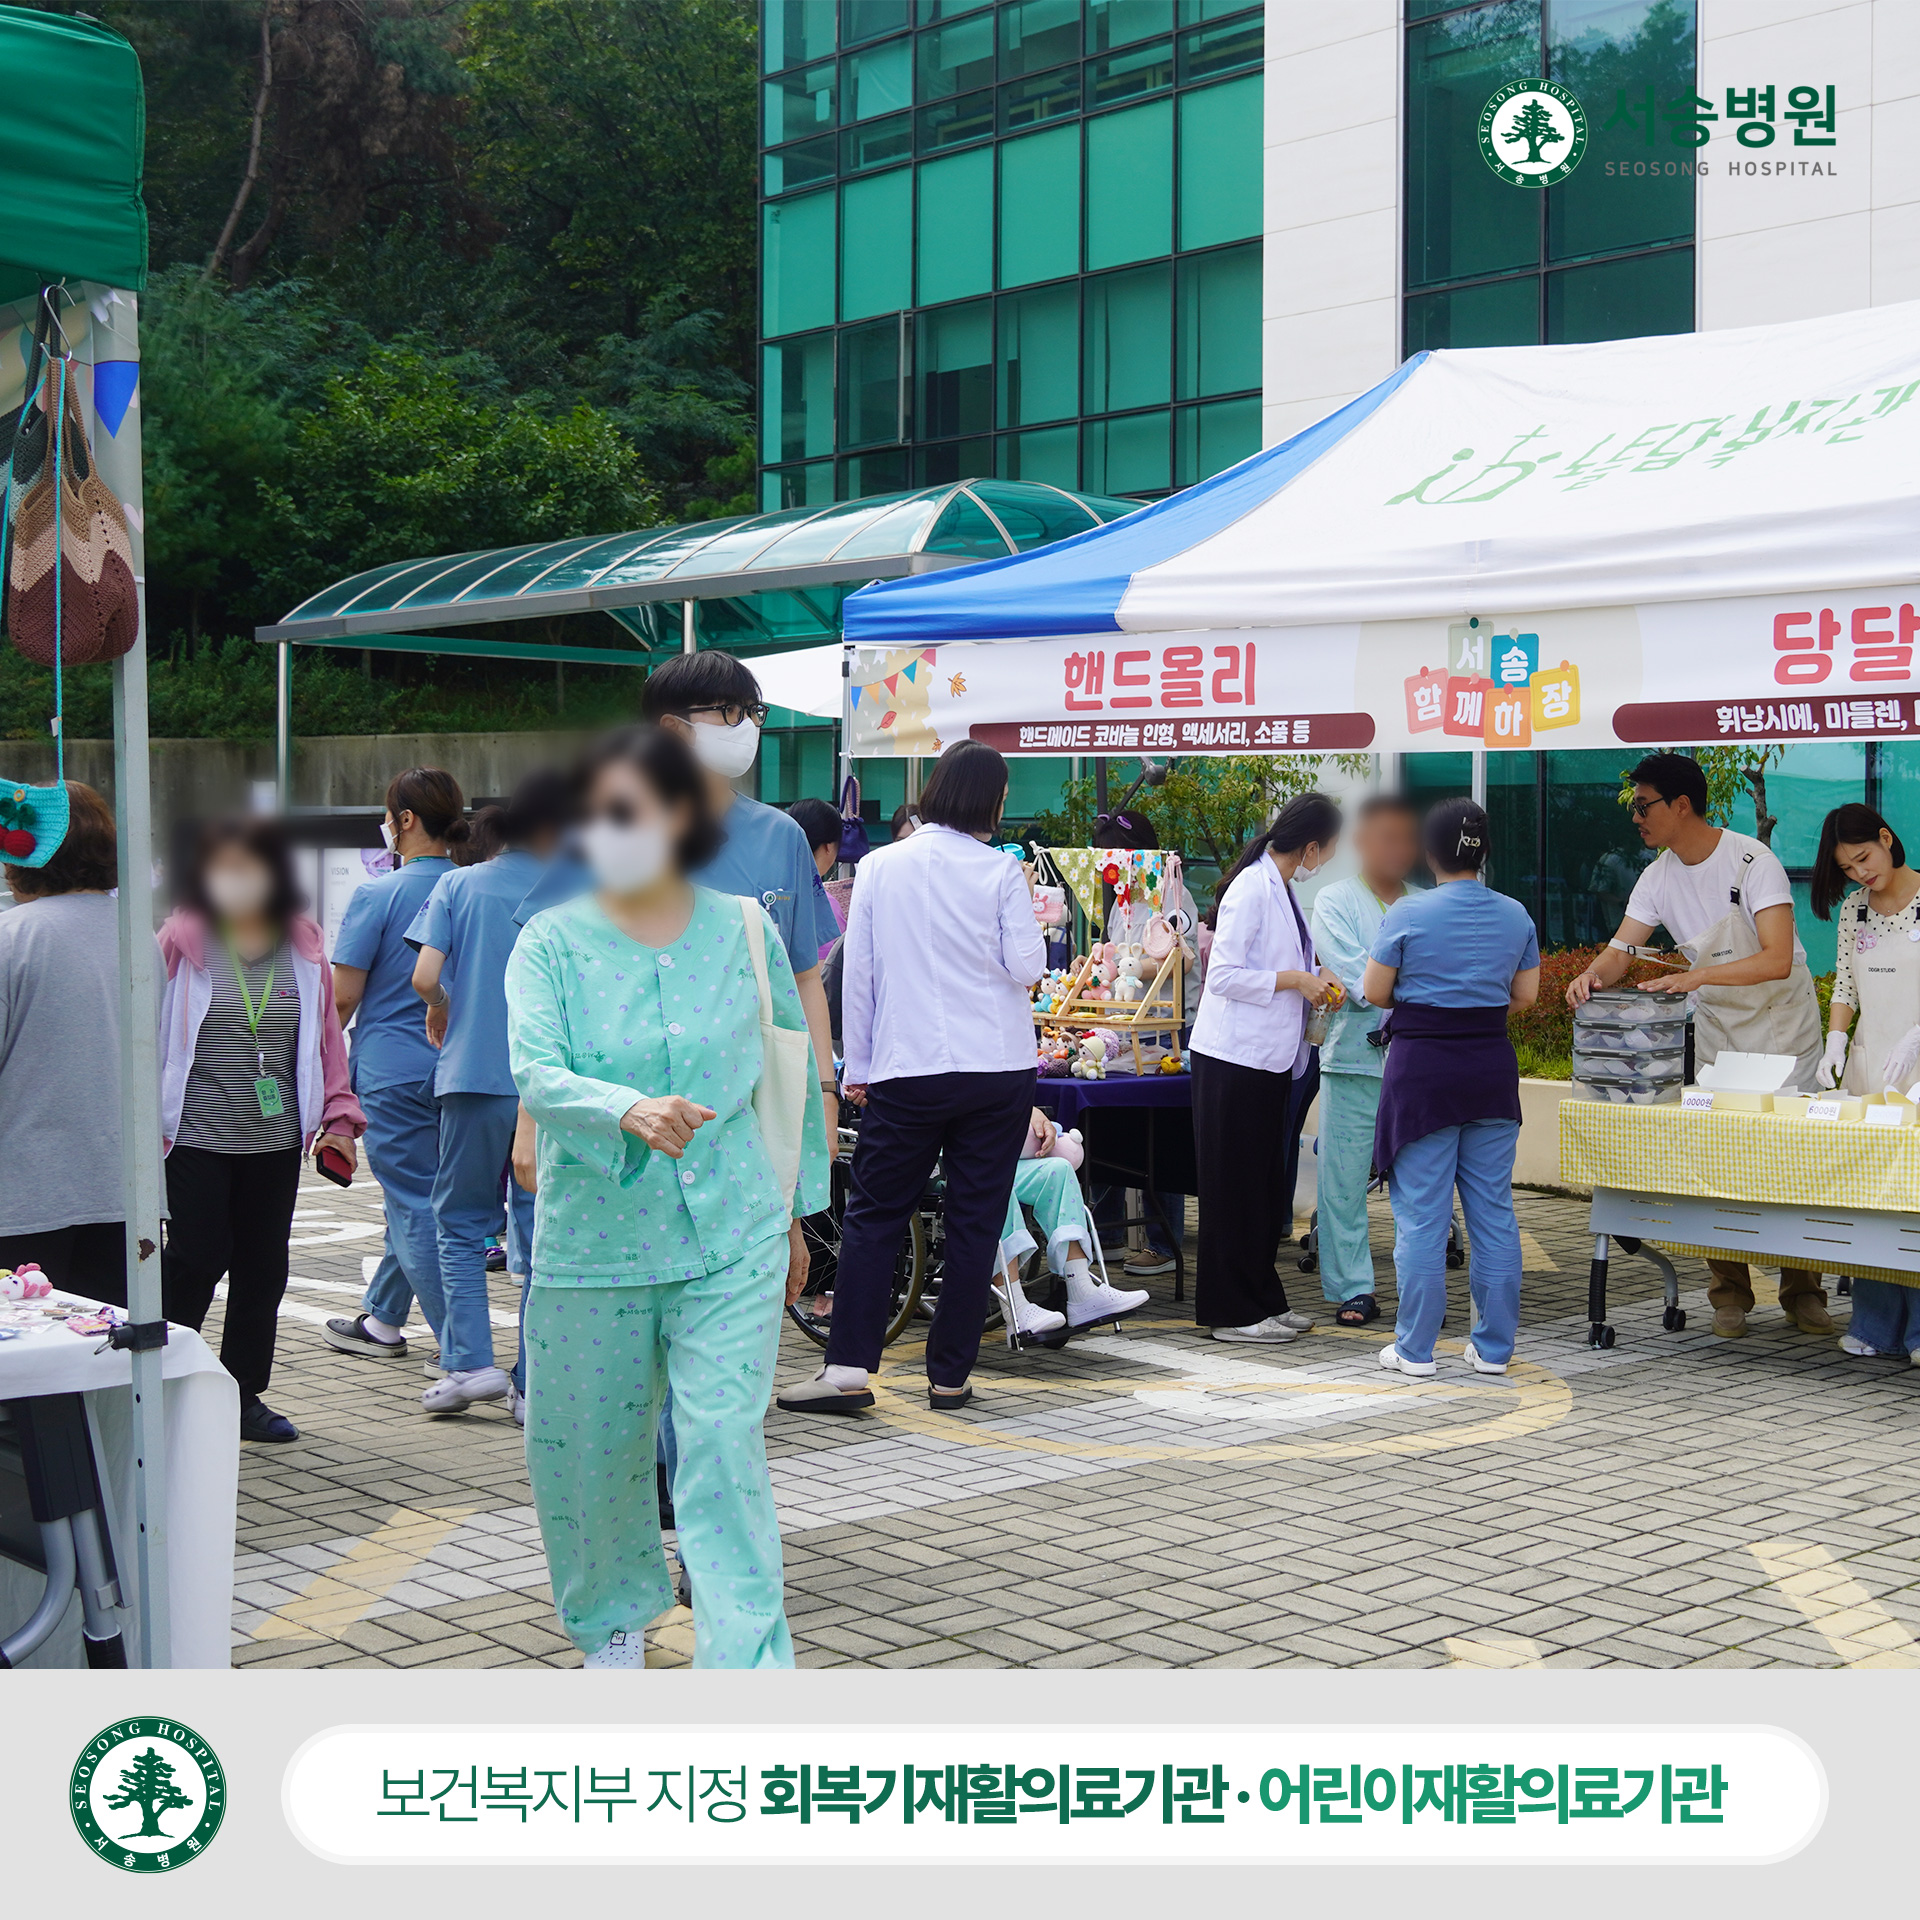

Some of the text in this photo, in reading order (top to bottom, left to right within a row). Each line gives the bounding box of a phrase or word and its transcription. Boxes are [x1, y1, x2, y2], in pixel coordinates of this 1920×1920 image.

[1456, 636, 1529, 682] 서송
[1773, 603, 1920, 685] 당달
[1064, 641, 1256, 711] 핸드올리
[1413, 679, 1573, 737] 함께하장
[1715, 703, 1820, 734] 휘낭시에,
[1824, 699, 1908, 731] 마들렌,
[1019, 719, 1311, 749] 핸드메이드 코바늘 인형, 액세서리, 소품 등
[331, 867, 350, 876] VISION
